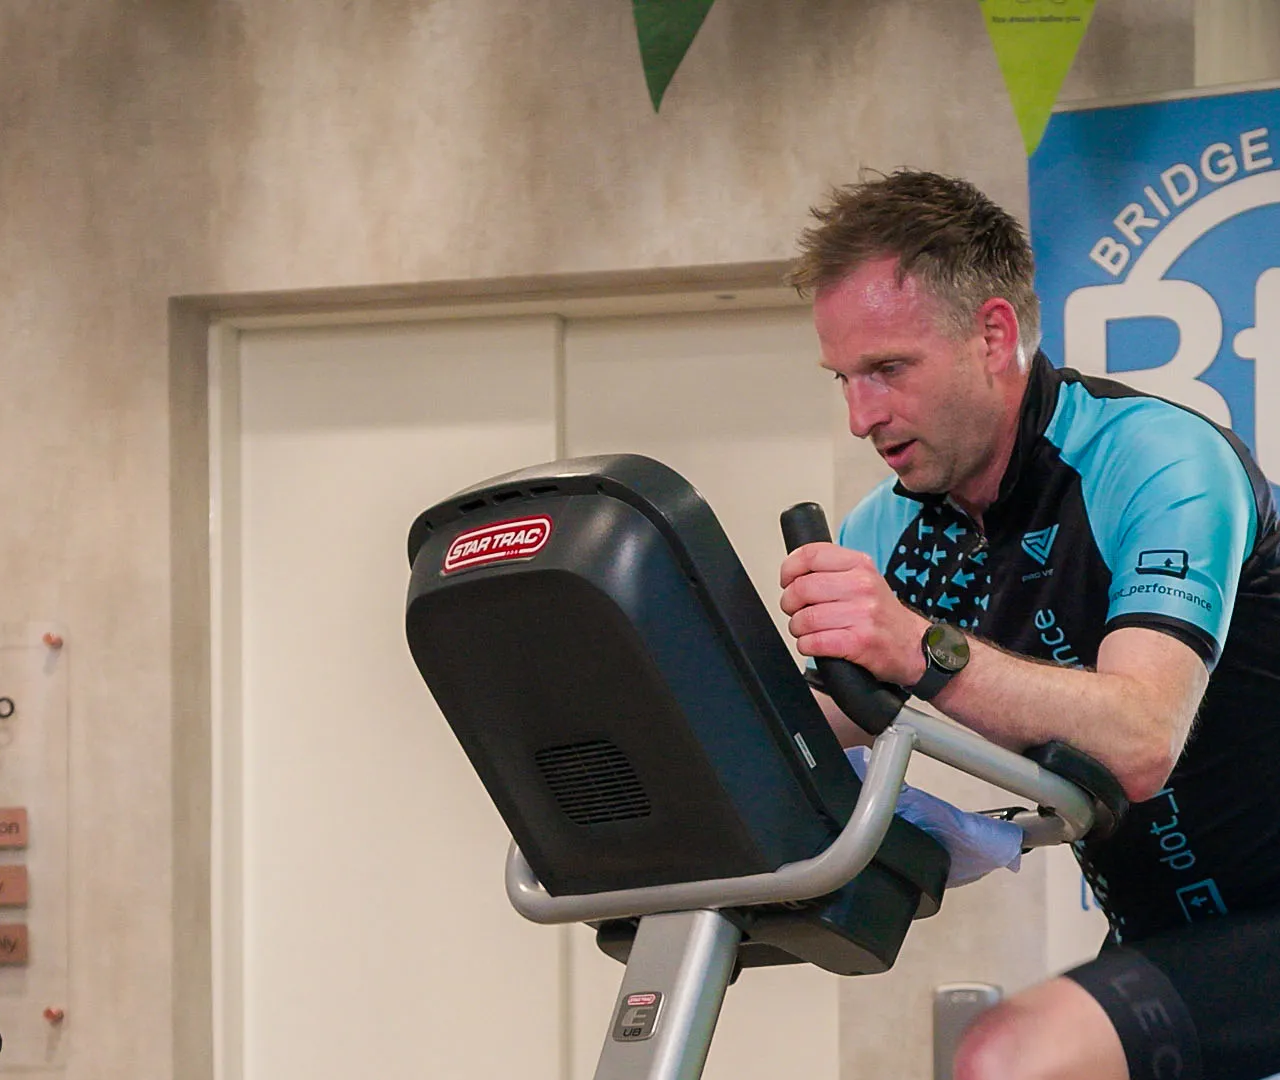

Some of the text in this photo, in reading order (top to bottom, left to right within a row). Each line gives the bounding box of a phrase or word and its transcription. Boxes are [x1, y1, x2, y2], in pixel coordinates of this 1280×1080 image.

[1090, 127, 1274, 278] BRIDGE
[449, 527, 541, 561] STAR TRAC
